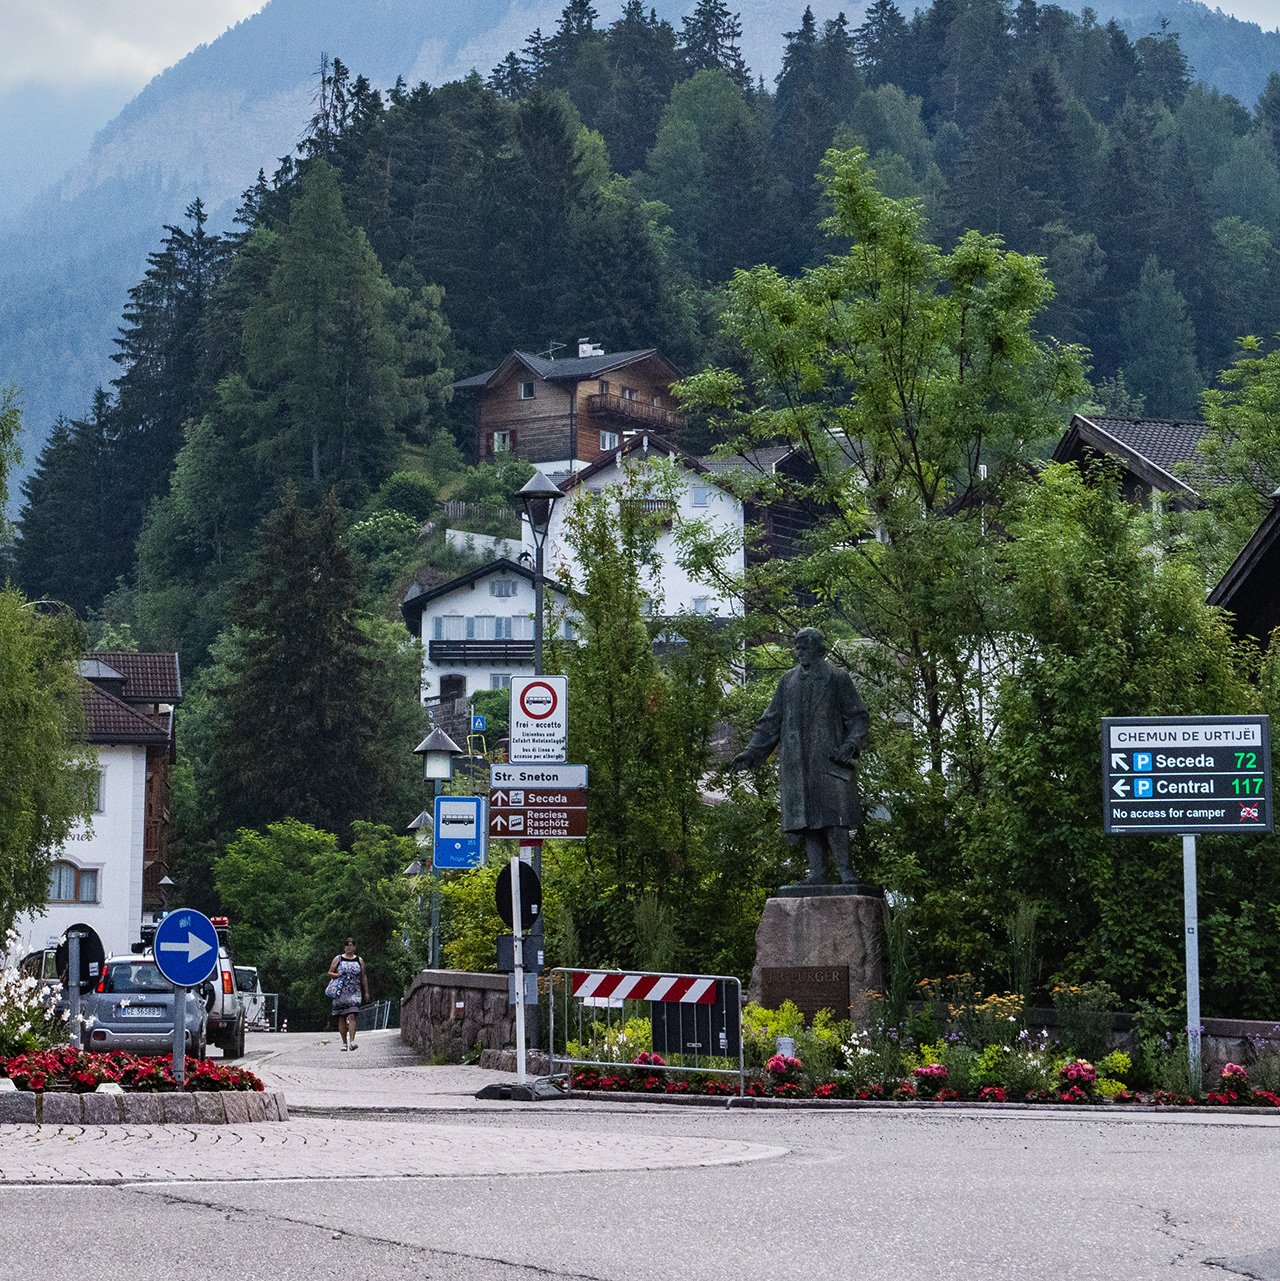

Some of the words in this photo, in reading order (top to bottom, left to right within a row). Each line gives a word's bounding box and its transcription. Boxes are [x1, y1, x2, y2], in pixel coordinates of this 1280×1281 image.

[1118, 732, 1177, 742] CHEMUN
[1182, 731, 1199, 741] DE
[1205, 728, 1255, 741] URTIJËI
[1156, 754, 1215, 768] Seceda
[1234, 752, 1257, 768] 72
[495, 772, 515, 781] Str.
[519, 772, 559, 781] Sneton
[1156, 780, 1214, 794] Central
[1232, 778, 1263, 795] 117
[528, 794, 567, 803] Seceda
[527, 810, 567, 818] Resciesa
[1113, 808, 1128, 819] No
[1130, 809, 1166, 818] access
[1169, 808, 1185, 818] for
[1187, 809, 1226, 819] camper
[527, 819, 569, 827] Raschötz
[791, 971, 840, 982] PURGER
